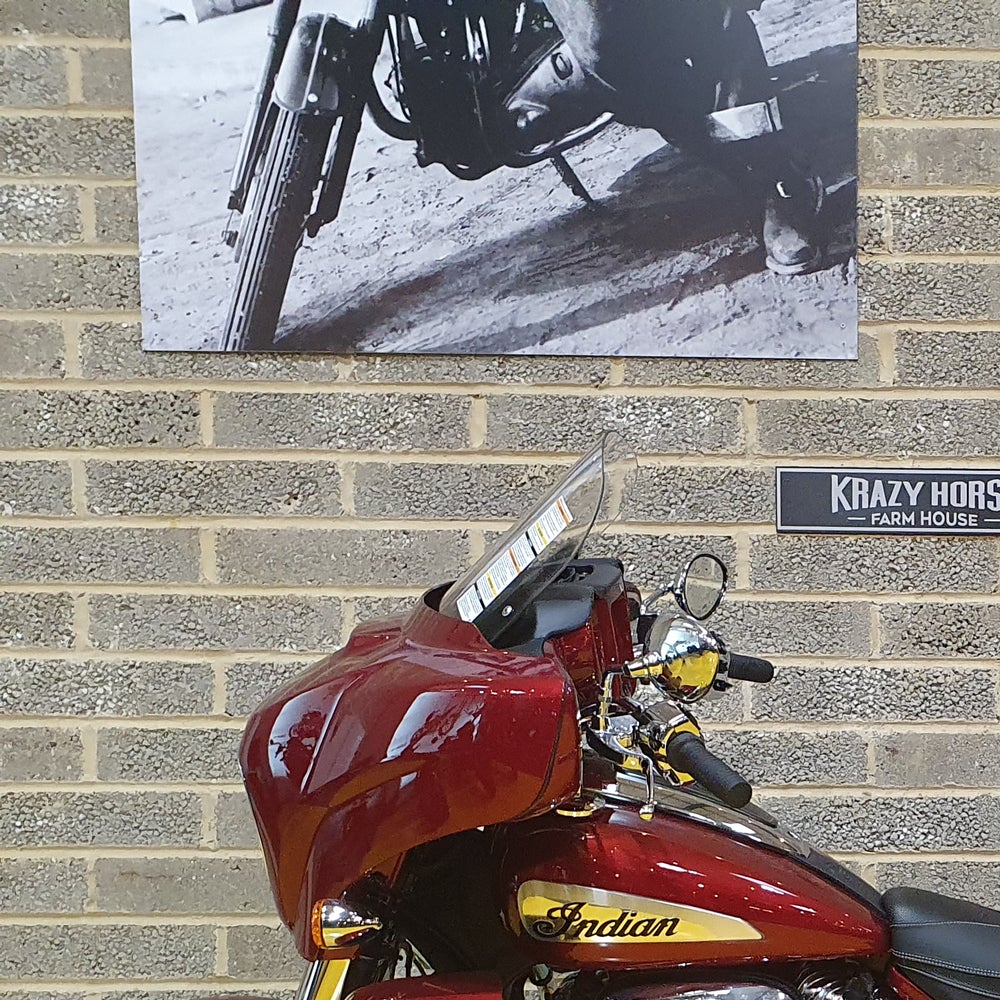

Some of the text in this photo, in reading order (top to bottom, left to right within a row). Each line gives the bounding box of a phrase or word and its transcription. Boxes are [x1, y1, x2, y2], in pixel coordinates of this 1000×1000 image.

[831, 474, 925, 513] KRAZY
[871, 511, 979, 527] FARM HOUSE
[532, 902, 681, 938] Indian
